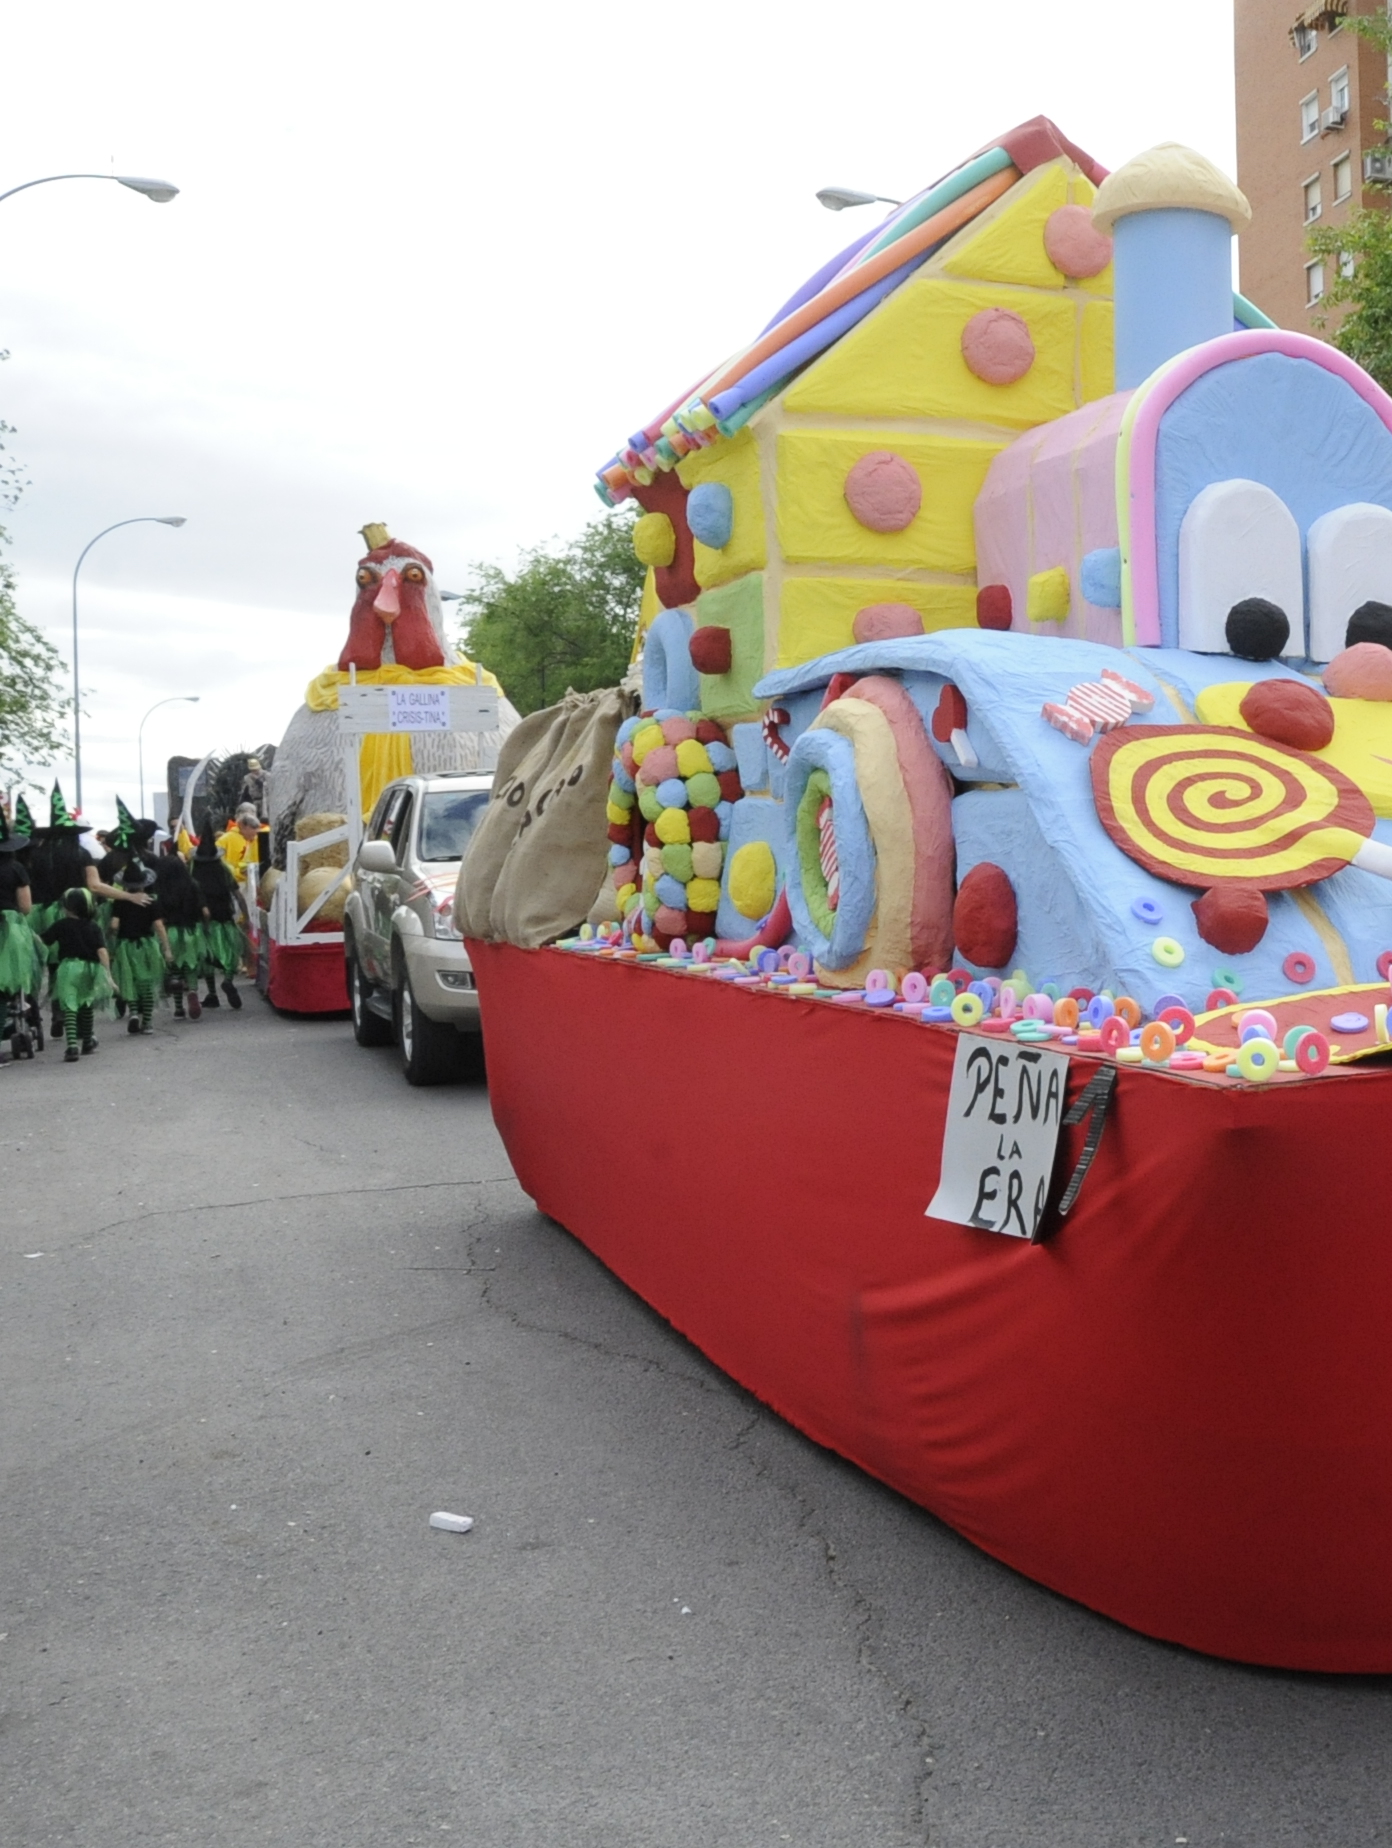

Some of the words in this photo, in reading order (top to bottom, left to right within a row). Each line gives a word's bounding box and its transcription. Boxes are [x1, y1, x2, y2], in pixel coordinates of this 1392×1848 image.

[396, 692, 407, 706] LA
[409, 692, 441, 706] GALLINA
[963, 1046, 1060, 1127] PEÑA
[997, 1133, 1023, 1161] LA
[968, 1165, 1047, 1242] ERA
